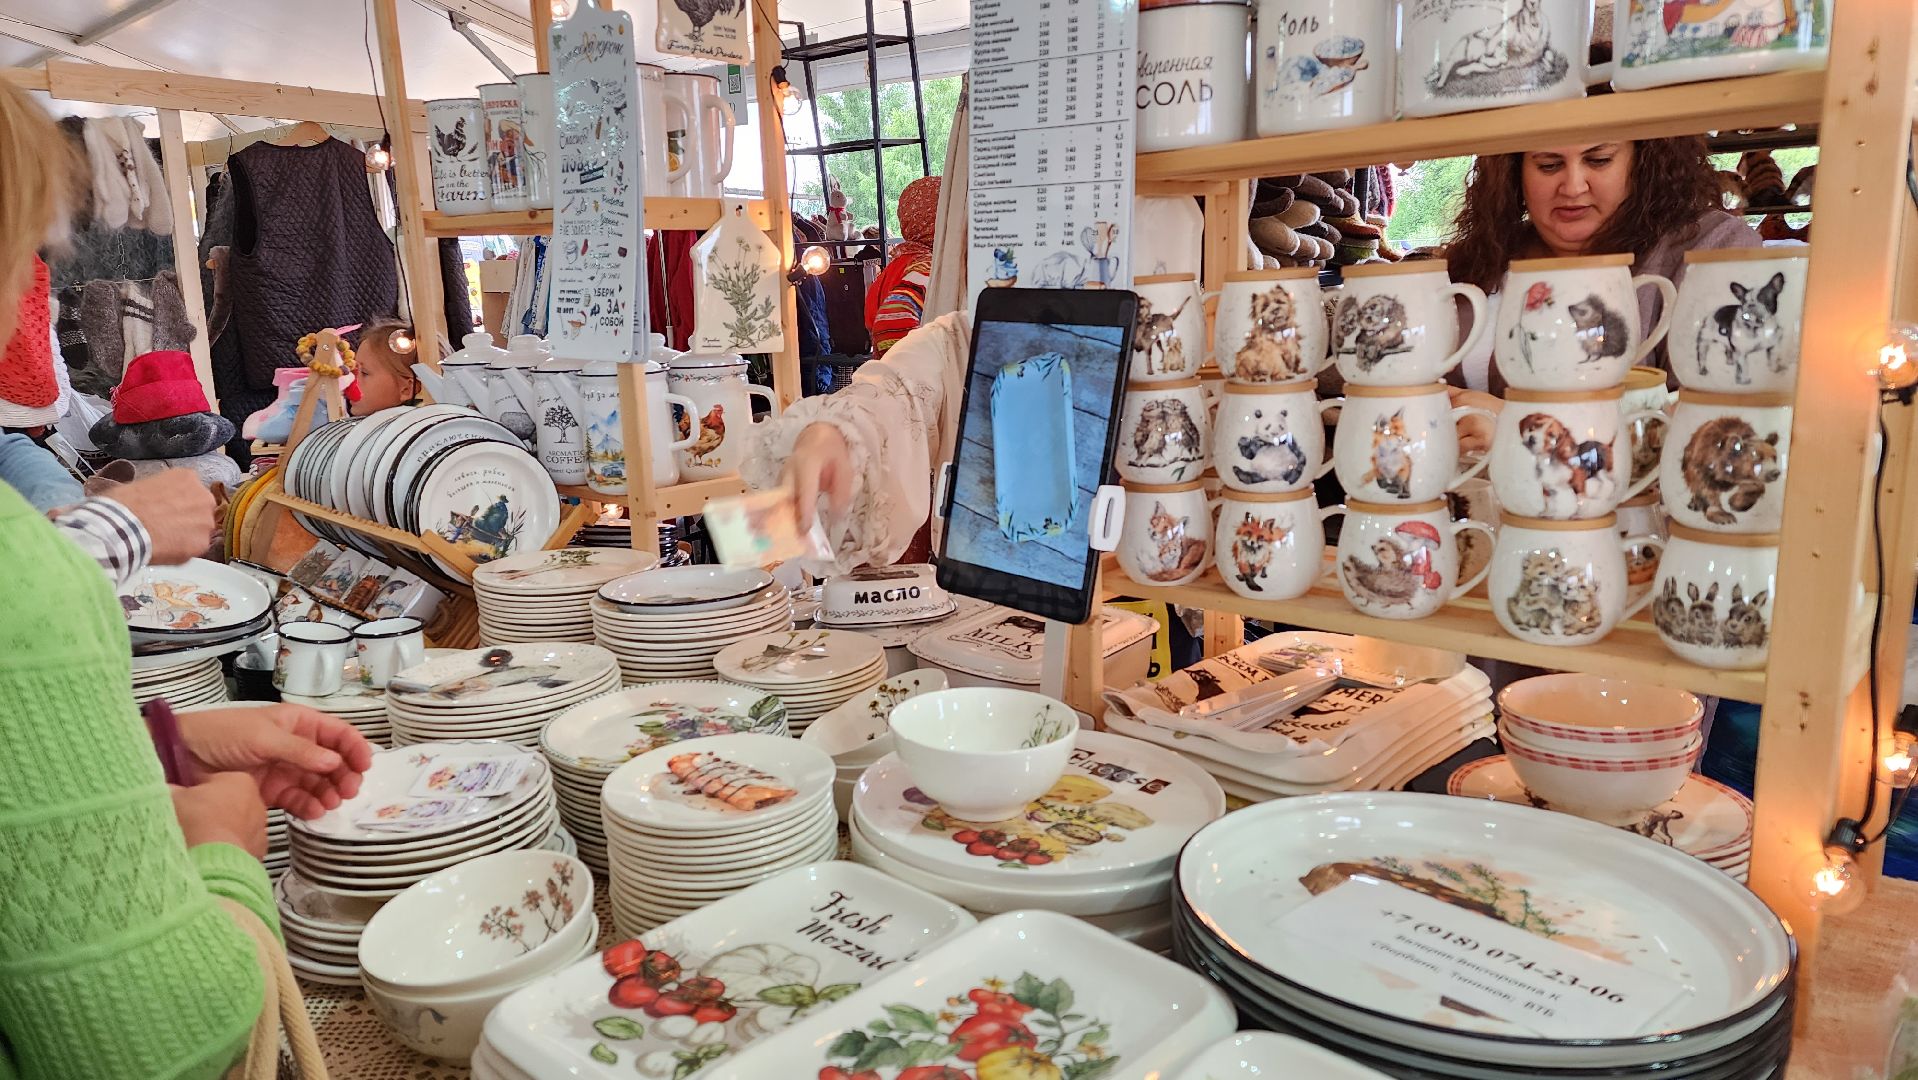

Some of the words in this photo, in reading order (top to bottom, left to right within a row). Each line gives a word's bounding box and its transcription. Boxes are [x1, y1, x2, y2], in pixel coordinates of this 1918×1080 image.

[667, 39, 689, 50] Farm
[1136, 79, 1213, 109] СОЛЬ
[460, 164, 489, 178] better
[607, 298, 620, 314] ЗА
[600, 315, 625, 326] СОБОЙ
[853, 584, 921, 605] масло
[964, 628, 1044, 652] MILK
[811, 891, 893, 936] Fresh
[1414, 923, 1480, 951] (918)
[1486, 948, 1625, 1003] 074-23-06
[1523, 1000, 1555, 1017] ВТБ
